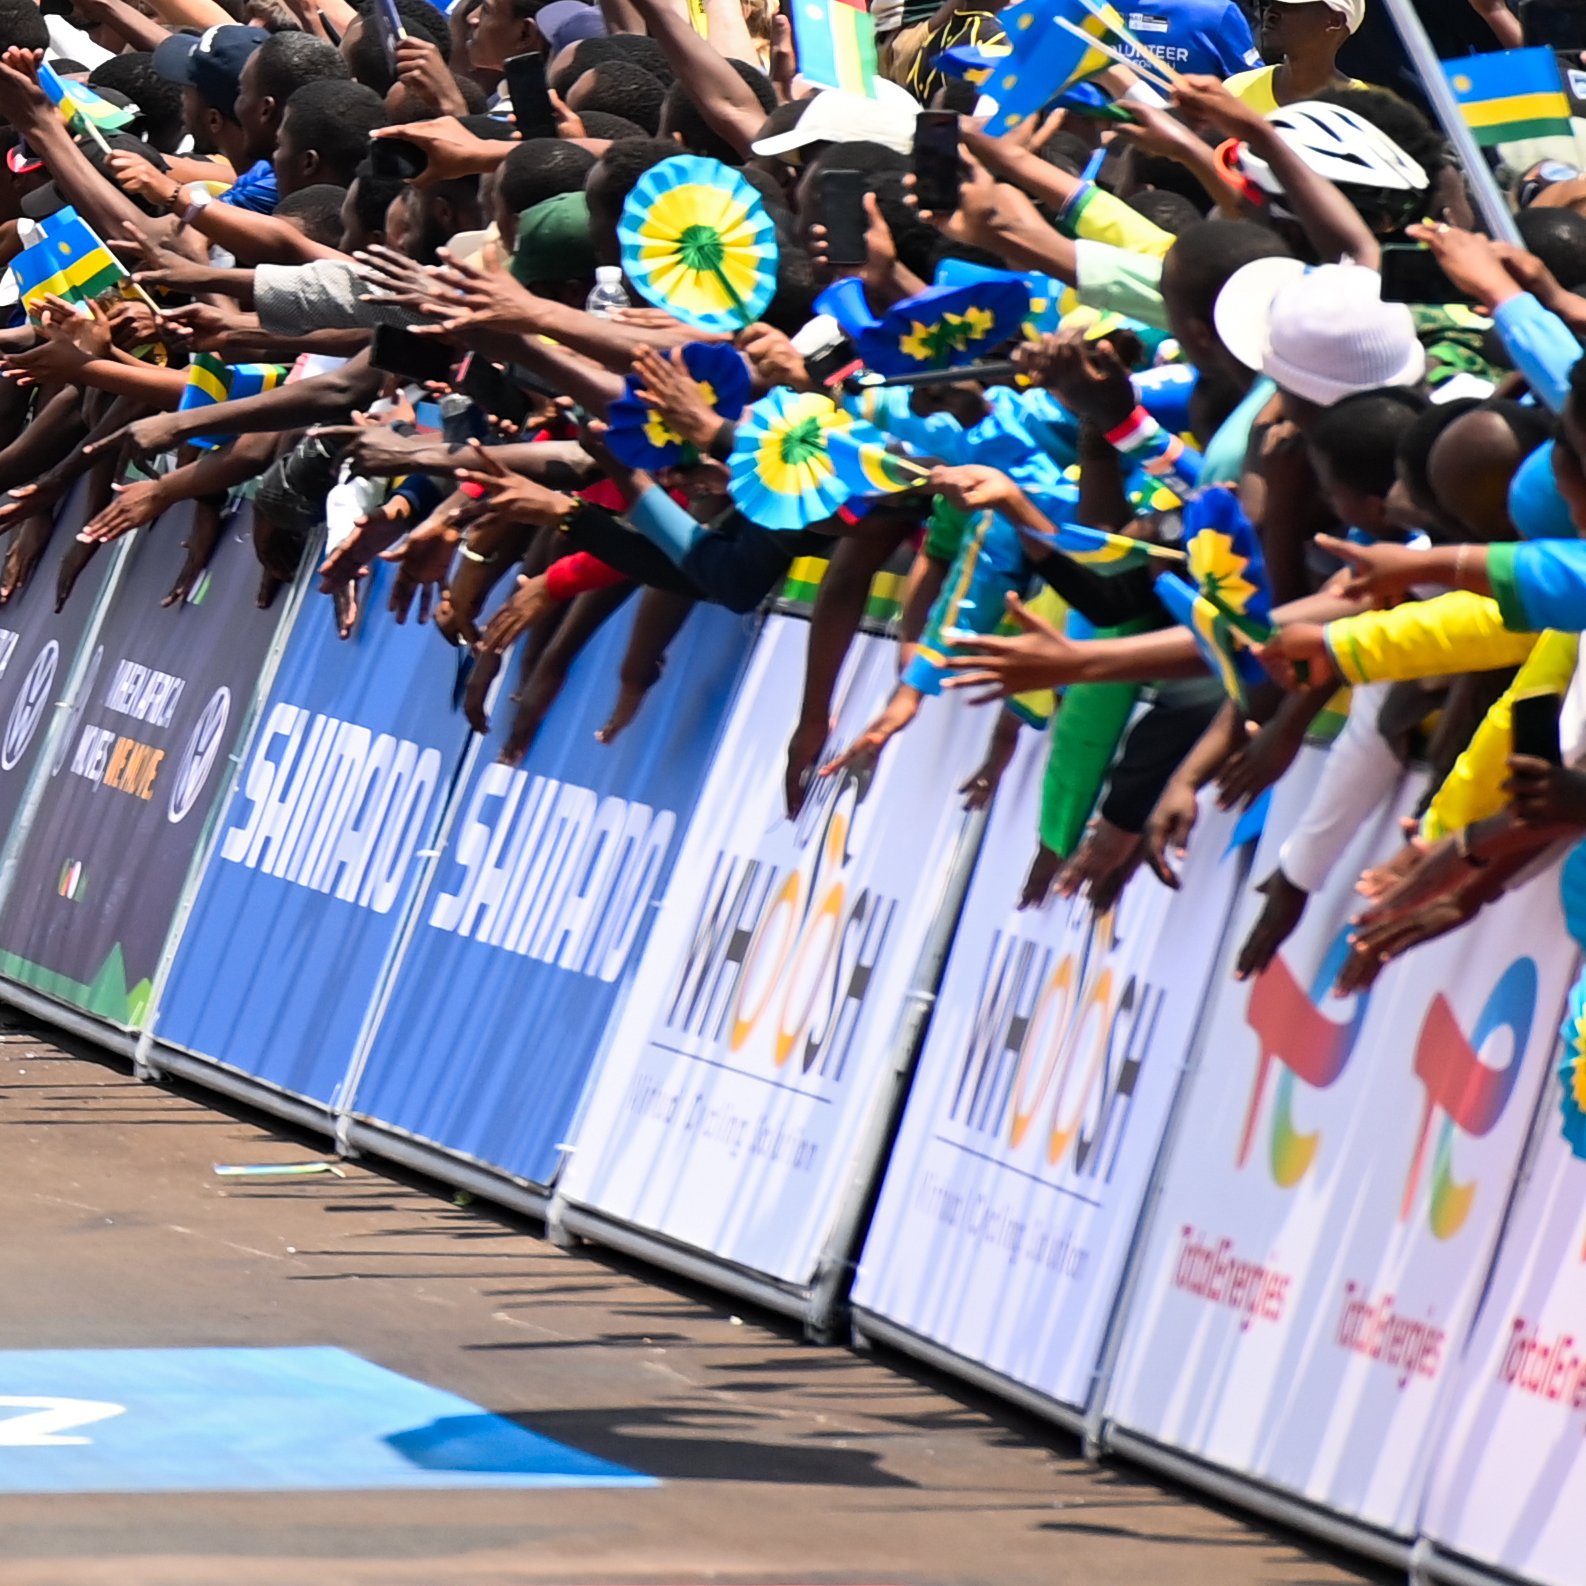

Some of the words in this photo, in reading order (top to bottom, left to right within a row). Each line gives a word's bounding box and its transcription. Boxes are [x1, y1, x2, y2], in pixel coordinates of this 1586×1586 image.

[221, 702, 441, 914] SHIMANO
[428, 762, 676, 982] SHIMANO
[668, 849, 899, 1082] WHOOSH
[951, 929, 1166, 1184] WHOOSH
